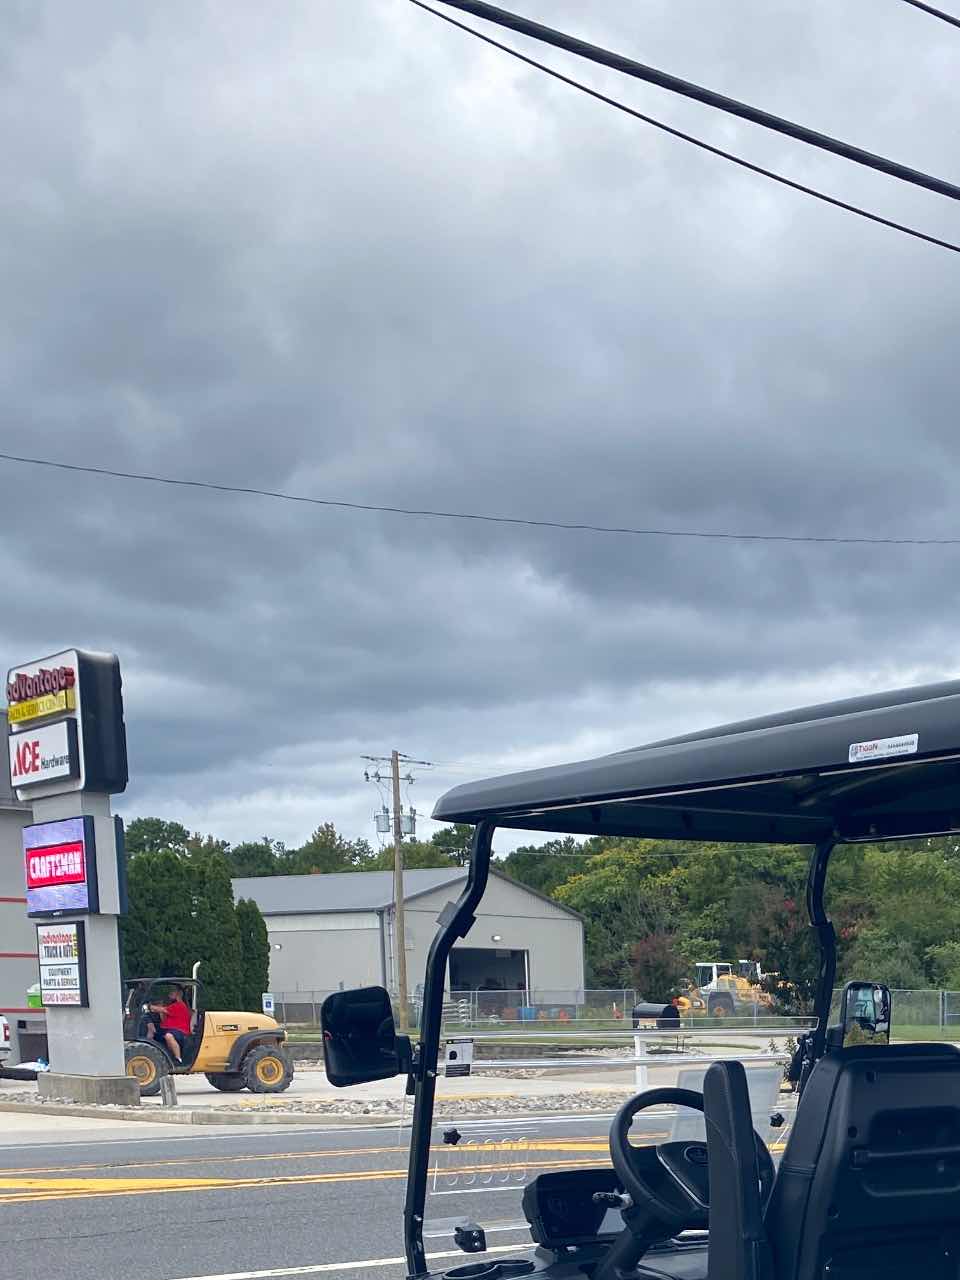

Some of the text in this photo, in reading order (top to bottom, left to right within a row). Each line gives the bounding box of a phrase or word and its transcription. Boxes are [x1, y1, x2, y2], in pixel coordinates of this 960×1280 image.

[13, 741, 39, 776] ACE
[41, 754, 71, 769] Hardware
[30, 851, 81, 879] CRAFTSMAN
